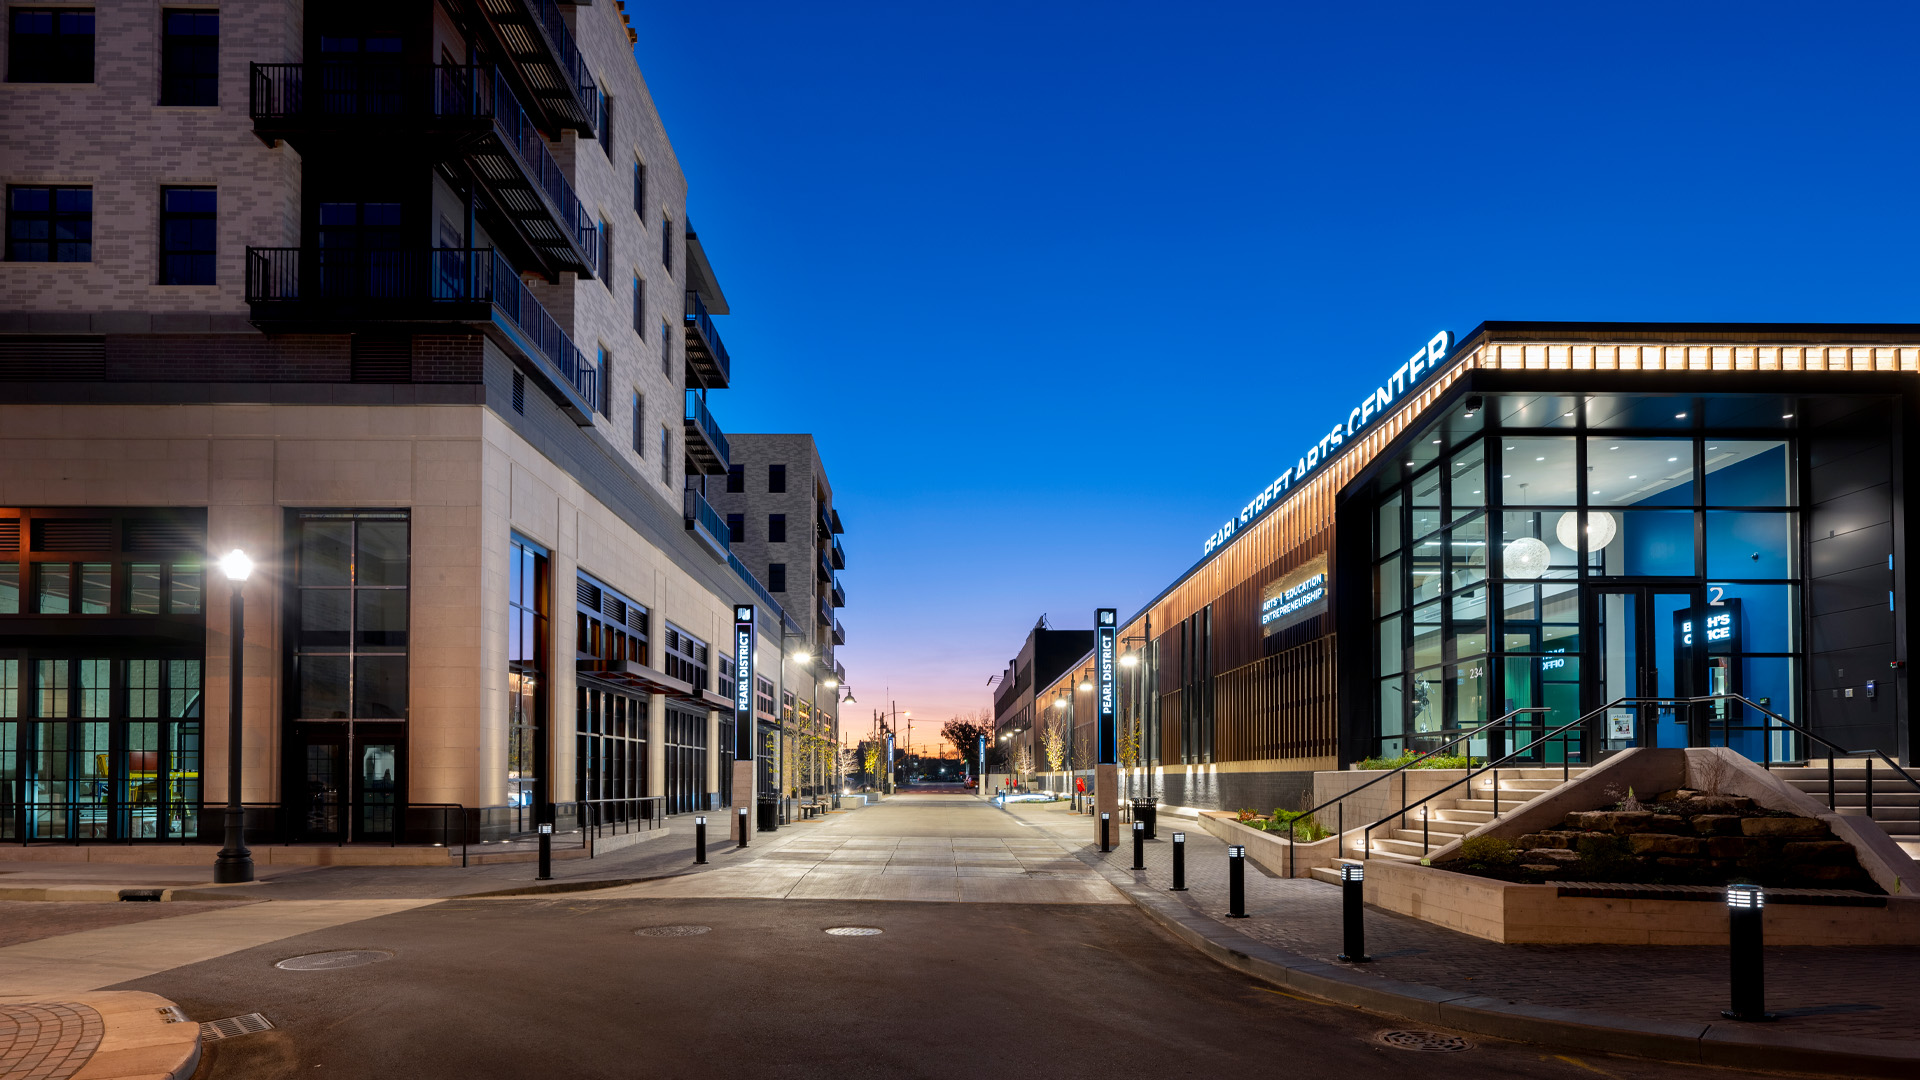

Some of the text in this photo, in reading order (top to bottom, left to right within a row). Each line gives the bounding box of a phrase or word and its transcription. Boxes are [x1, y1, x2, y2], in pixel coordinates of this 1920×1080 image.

[1295, 423, 1344, 481] ARTS
[1262, 573, 1324, 612] ARTS EDUCATION
[1262, 587, 1323, 624] ENTREPRENEURSHIP
[1709, 587, 1725, 606] 2
[739, 631, 749, 711] PEARL DISTRICT
[1102, 635, 1112, 714] PEARL DISTRICT
[1469, 666, 1484, 680] 234
